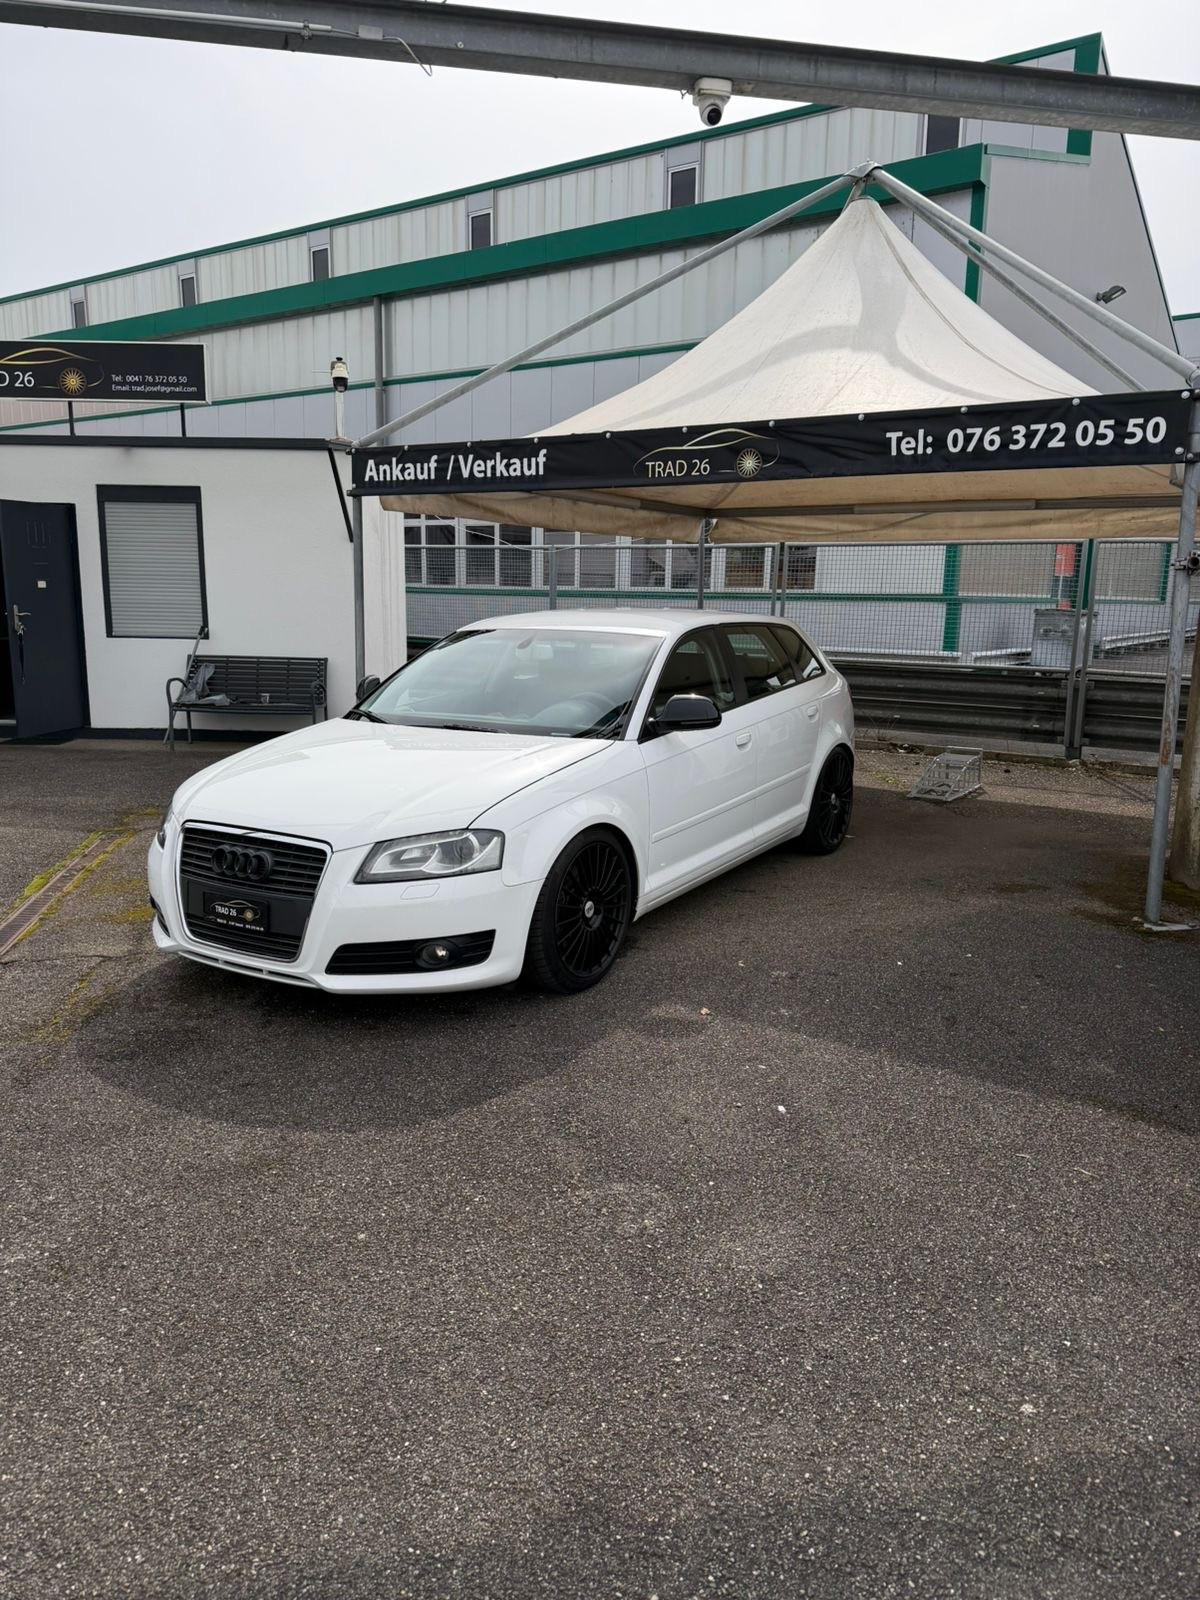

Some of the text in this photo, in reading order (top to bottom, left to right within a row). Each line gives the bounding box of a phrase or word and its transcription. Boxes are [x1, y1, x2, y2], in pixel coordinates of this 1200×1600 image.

[14, 371, 35, 387] 26
[111, 374, 123, 382] Tel:
[145, 375, 154, 383] 76
[155, 375, 167, 383] 372
[111, 384, 130, 392] Email:
[886, 416, 1167, 456] Tel: 076 372 05 50
[364, 456, 438, 482] Ankauf
[645, 458, 710, 478] TRAD 26
[215, 905, 229, 915] TRAD
